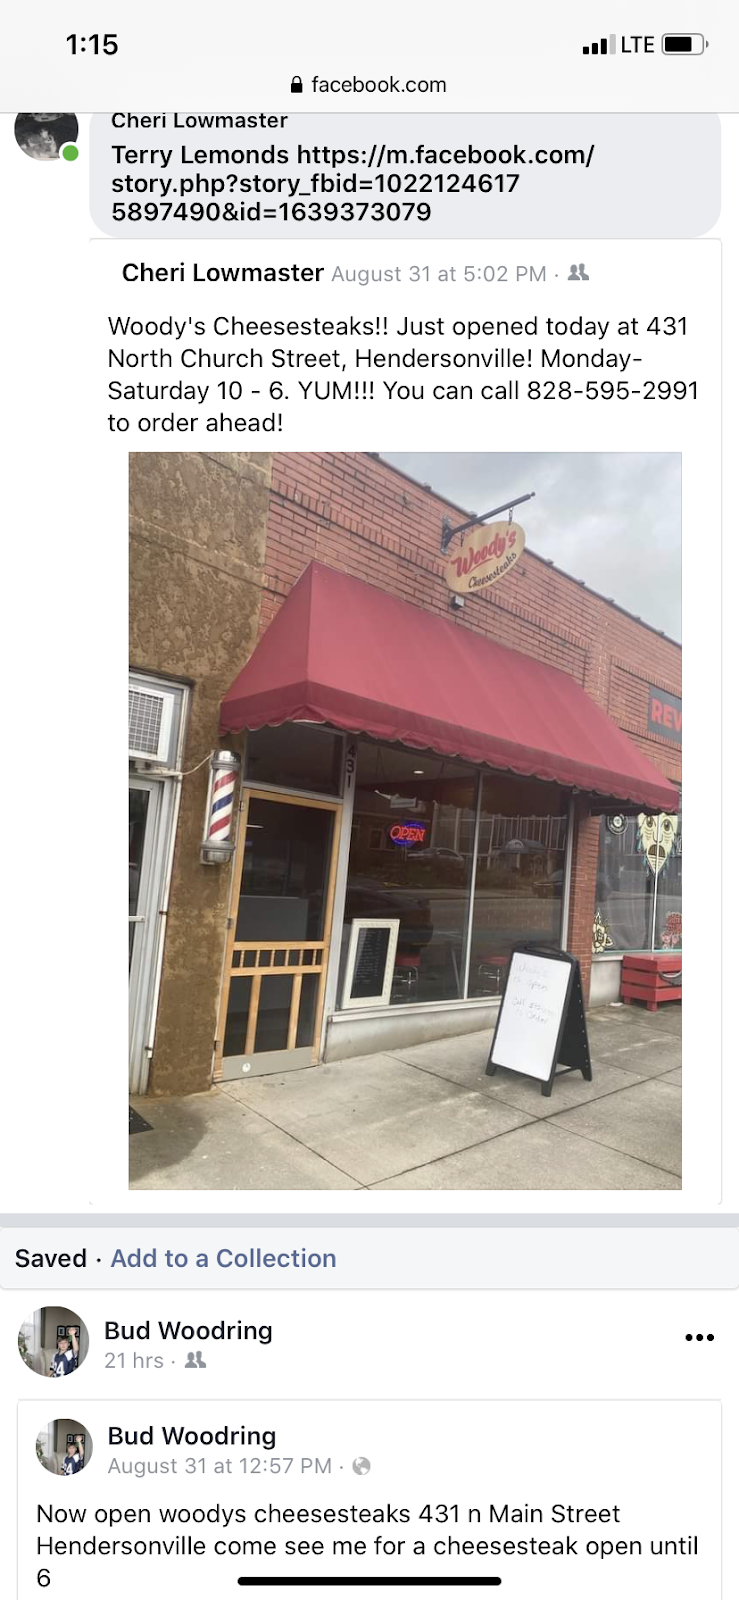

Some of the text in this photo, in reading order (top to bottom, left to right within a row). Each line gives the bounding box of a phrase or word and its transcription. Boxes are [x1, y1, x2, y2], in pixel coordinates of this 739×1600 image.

[67, 34, 118, 55] 1:15
[622, 36, 654, 53] LTE
[311, 76, 446, 92] facebook.com
[112, 112, 288, 128] Cheri Lowmaster
[111, 145, 595, 168] Terry Lemonds https://m.facebook.com/
[112, 172, 519, 197] story.php?story_fbid=1022124617
[112, 201, 431, 221] 5897490&id=1639373079
[122, 262, 324, 281] Cheri Lowmaster
[332, 266, 545, 286] August 31 at 5:02 PM
[108, 316, 686, 340] Woody's Cheesesteaks!! Just opened today at 431
[109, 348, 642, 372] North Church Street, Hendersonville! Monday-
[108, 380, 209, 404] Saturday
[218, 381, 242, 400] 10
[269, 381, 288, 400] 6.
[298, 381, 373, 400] YUM!!!
[383, 381, 423, 400] You
[433, 386, 472, 400] can
[481, 380, 518, 400] call
[527, 381, 698, 400] 828-595-2991
[108, 412, 282, 432] to order ahead!
[451, 530, 517, 578] Woody's
[469, 553, 516, 588] Cheesesteaks
[346, 745, 355, 788] 431
[390, 825, 426, 842] OPEN
[16, 1248, 336, 1268] Saved Add to a Collection
[105, 1320, 272, 1345] Bud Woodring
[105, 1352, 163, 1368] 21 hrs
[109, 1425, 275, 1450] Bud Woodring
[108, 1458, 331, 1478] August 31 at 12:57 PM
[37, 1503, 620, 1527] Now open woodys cheesesteaks 431 n Main Street
[37, 1536, 698, 1559] Hendersonville come see me for a cheesesteak open until
[37, 1568, 50, 1587] 6
